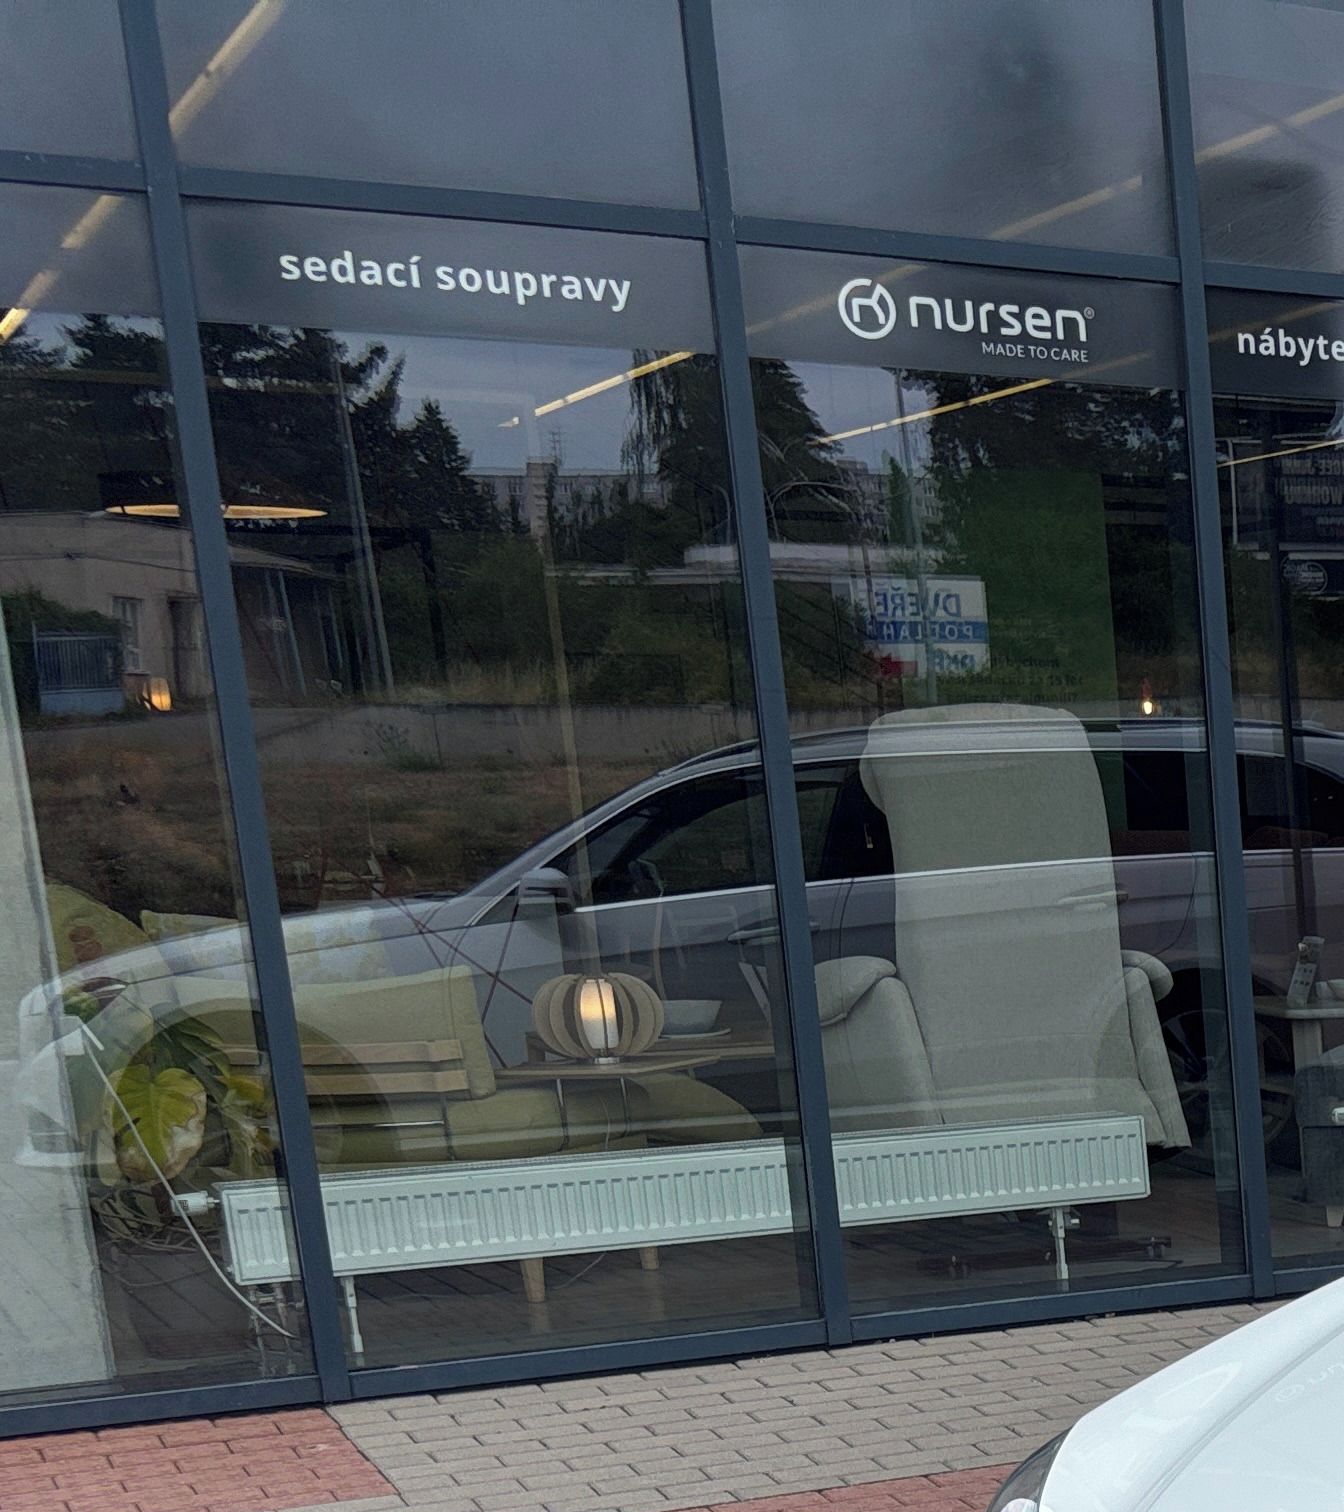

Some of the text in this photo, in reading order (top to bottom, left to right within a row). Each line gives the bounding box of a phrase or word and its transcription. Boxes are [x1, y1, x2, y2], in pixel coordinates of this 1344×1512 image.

[279, 250, 632, 313] sedací soupravy
[908, 295, 1088, 342] nursen
[981, 341, 1089, 363] MADE TO CARE
